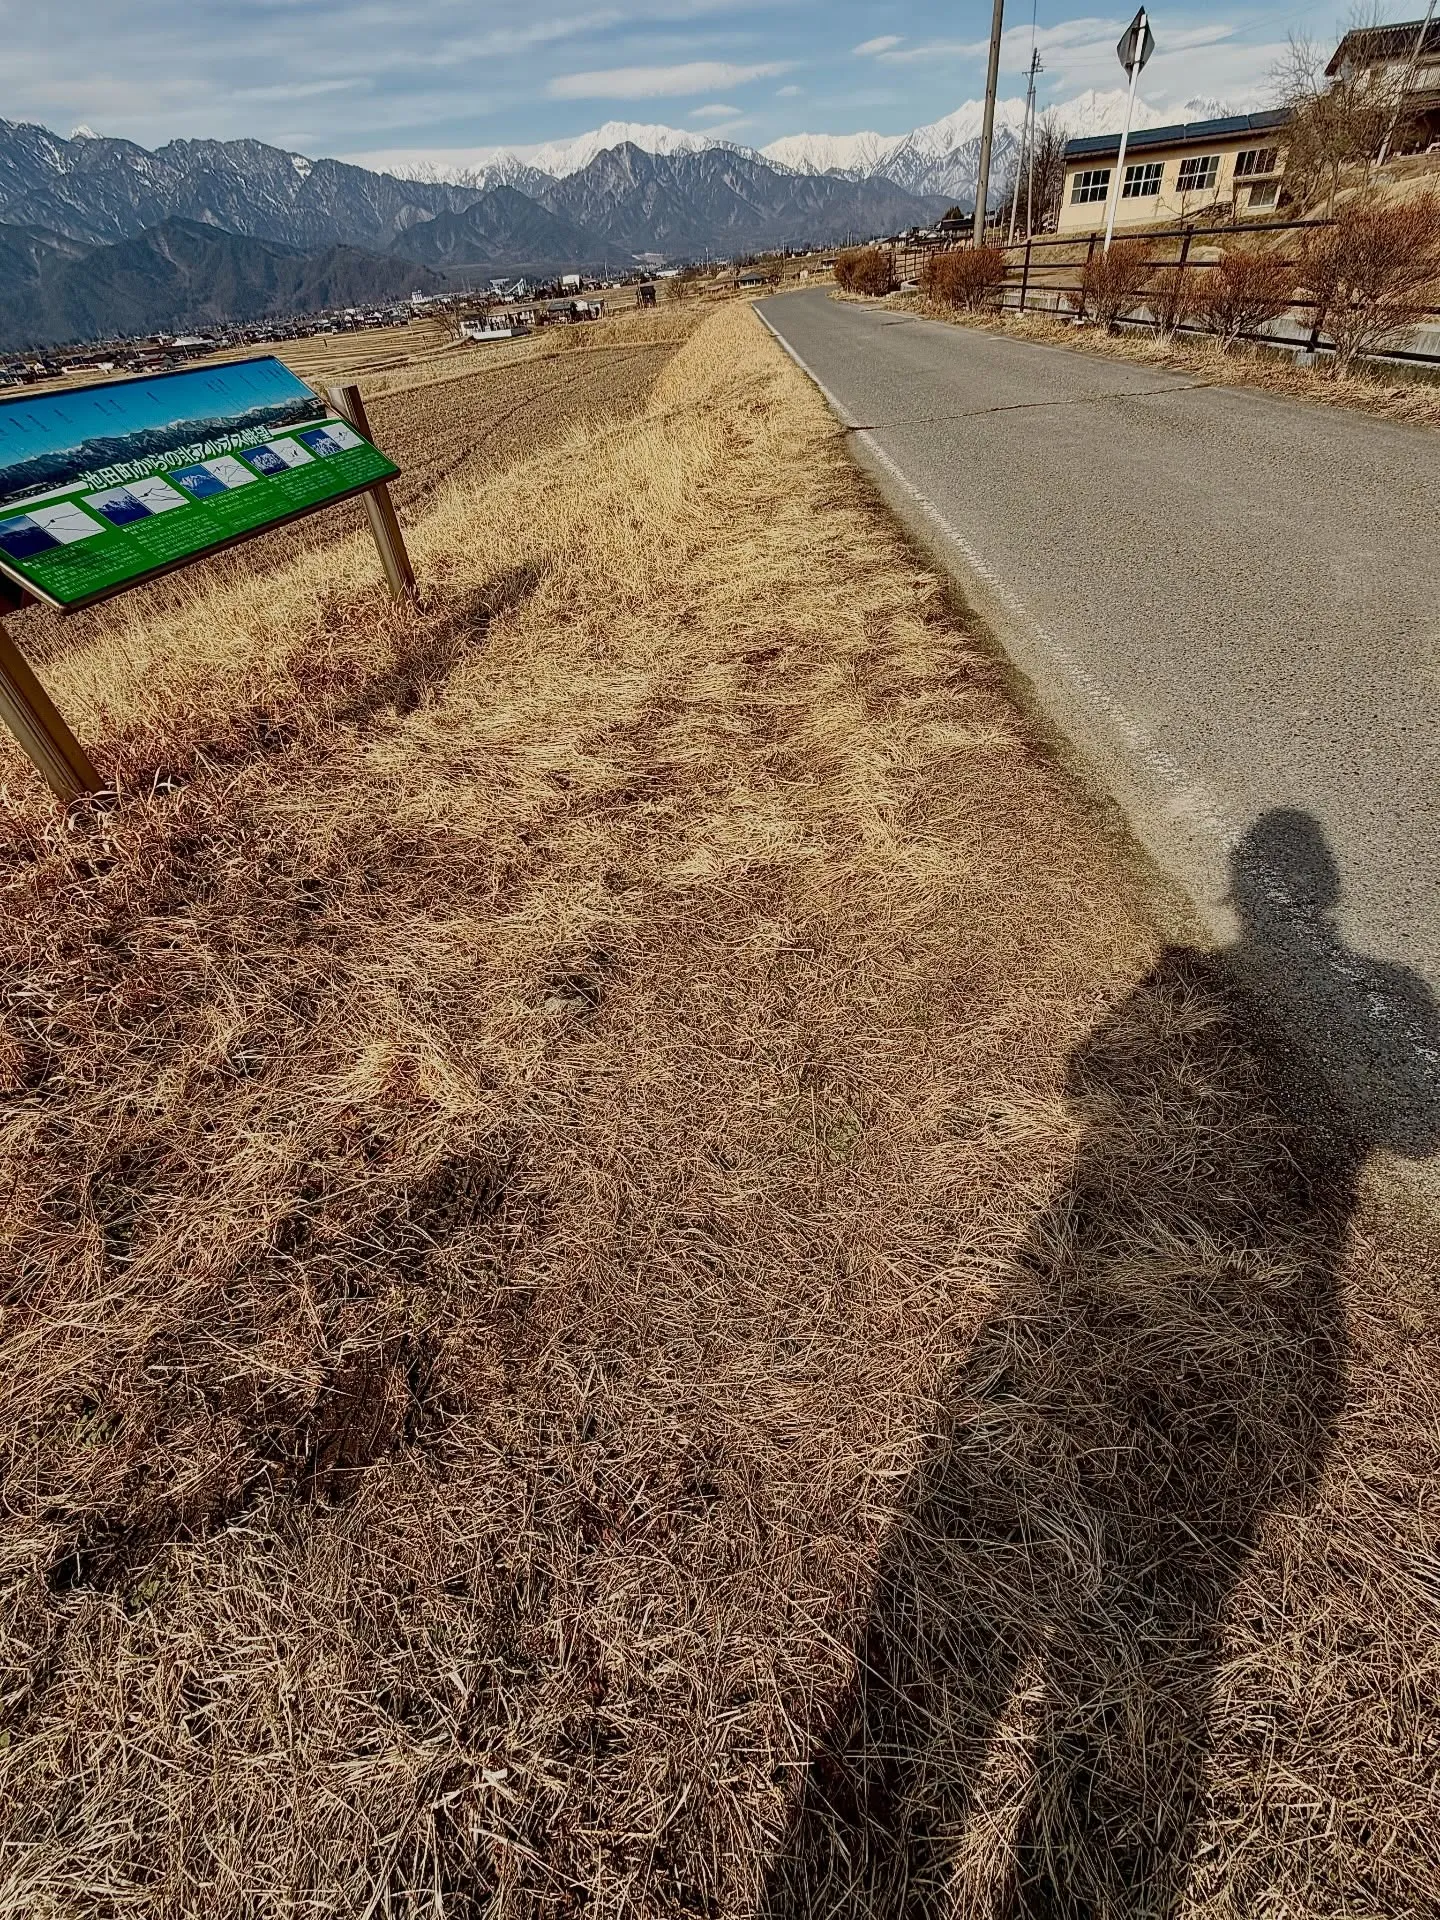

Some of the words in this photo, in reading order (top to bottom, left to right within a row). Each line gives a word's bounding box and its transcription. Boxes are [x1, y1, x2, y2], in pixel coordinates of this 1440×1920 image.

[77, 425, 274, 490] 池田町からの北アルプス眺望
